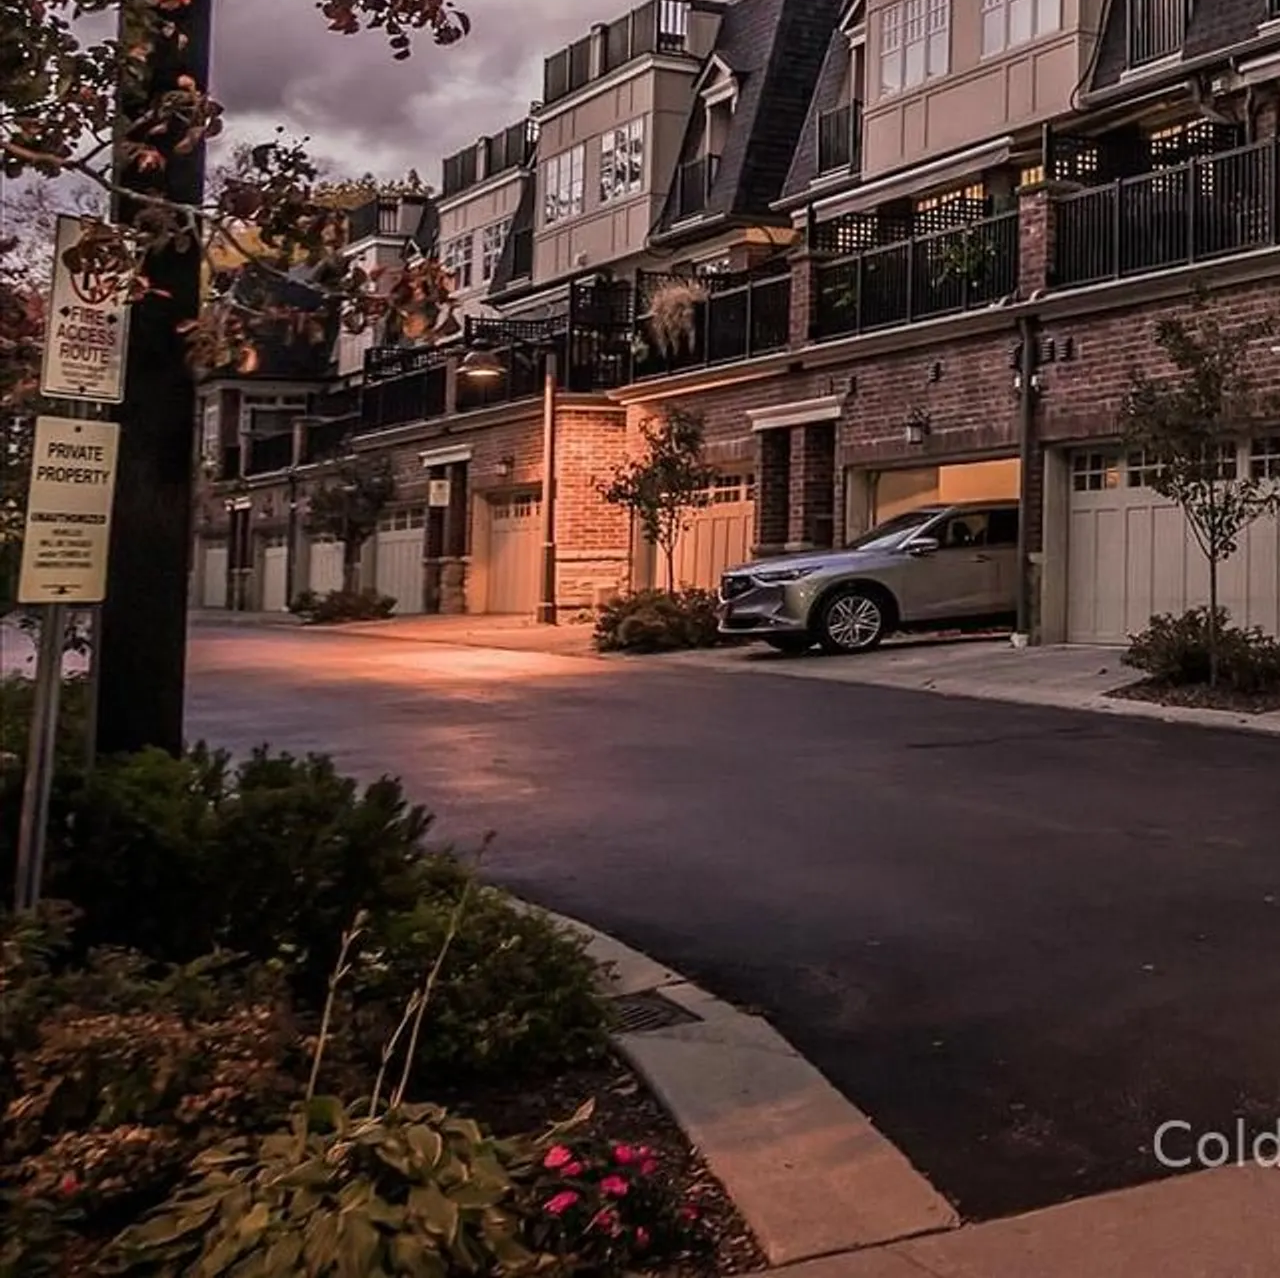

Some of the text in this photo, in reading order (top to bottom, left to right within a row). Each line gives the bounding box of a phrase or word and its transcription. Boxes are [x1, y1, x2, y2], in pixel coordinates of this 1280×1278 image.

[70, 305, 105, 325] FIRE
[56, 323, 116, 346] ACCESS
[60, 341, 110, 364] ROUTE
[47, 442, 105, 462] PRIVATE
[36, 466, 111, 485] PROPERTY
